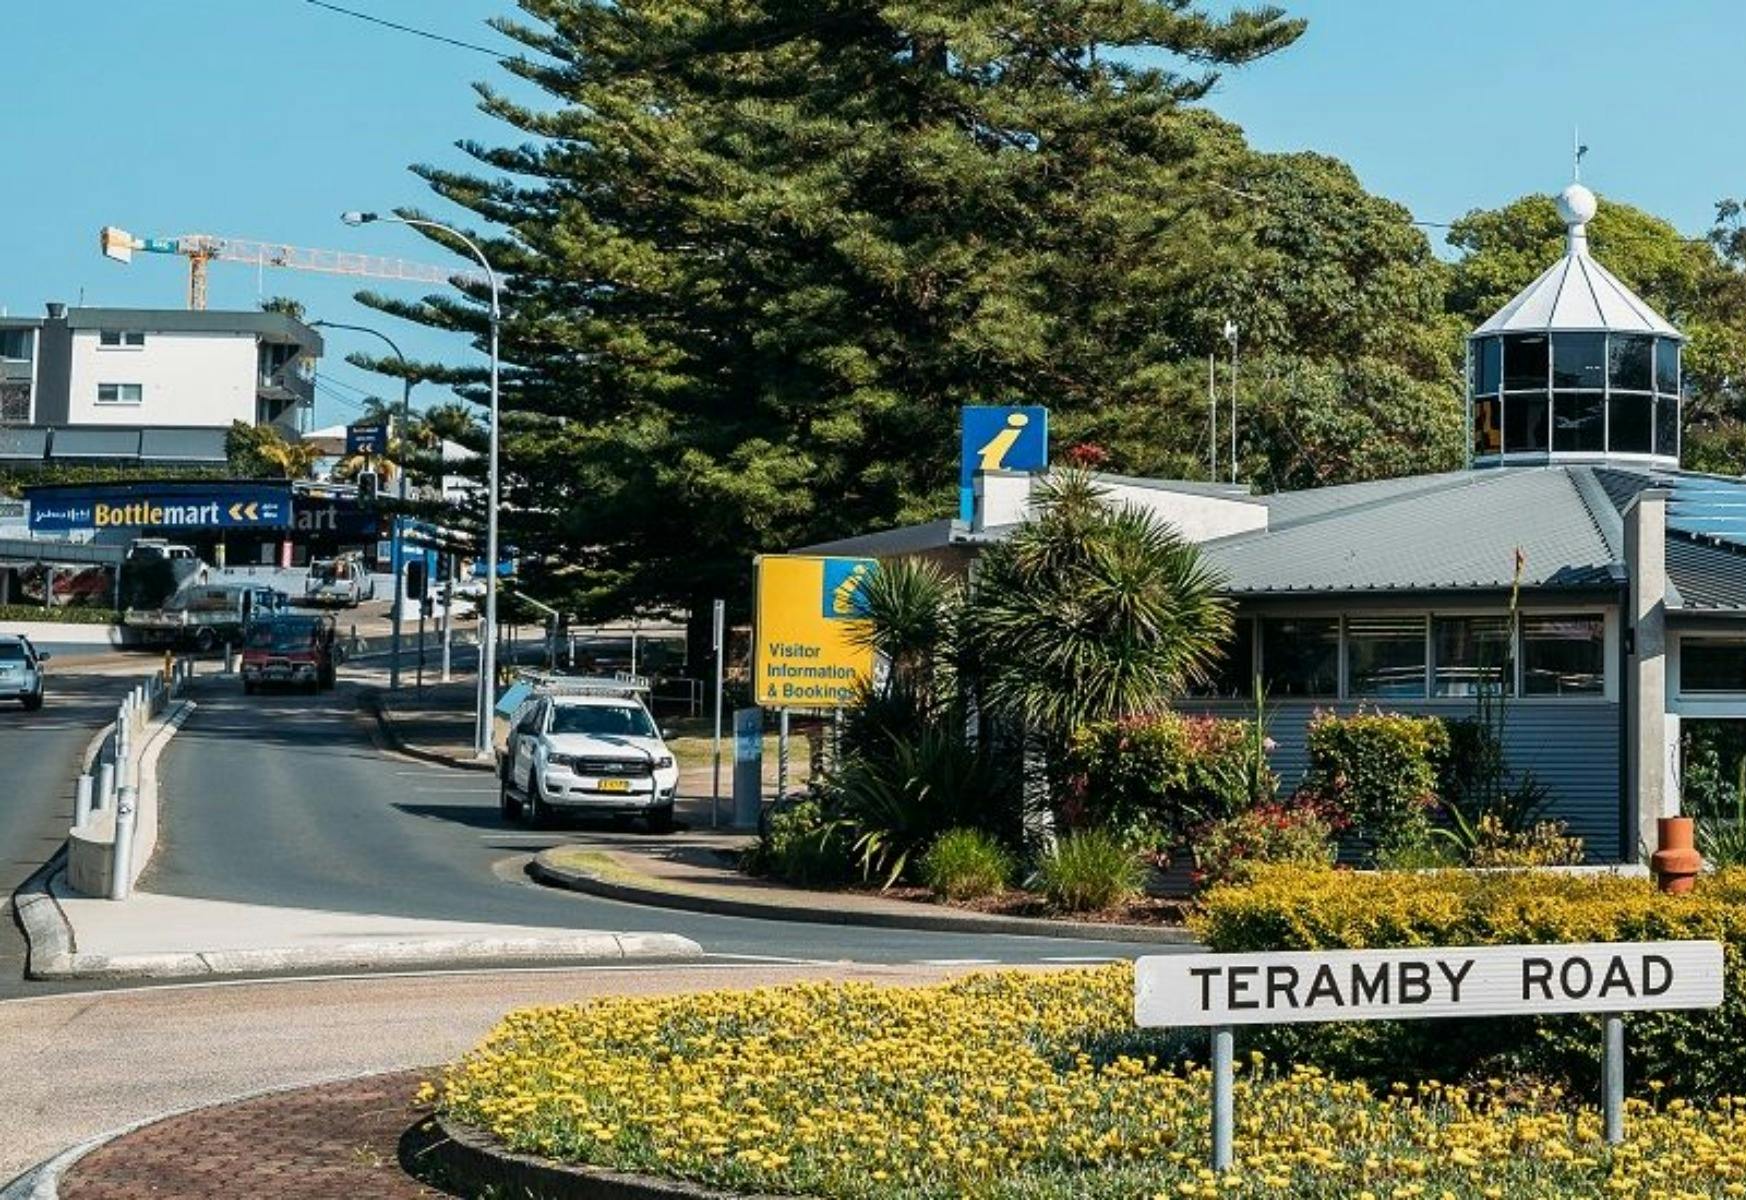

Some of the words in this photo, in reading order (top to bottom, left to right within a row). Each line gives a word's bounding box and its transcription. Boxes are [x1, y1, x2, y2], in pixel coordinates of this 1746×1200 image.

[95, 502, 219, 526] Bottlemart
[769, 643, 821, 657] Visitor
[767, 663, 855, 679] Information
[768, 683, 777, 698] &
[1190, 960, 1475, 1010] TERAMBY
[1522, 954, 1674, 1001] ROAD
